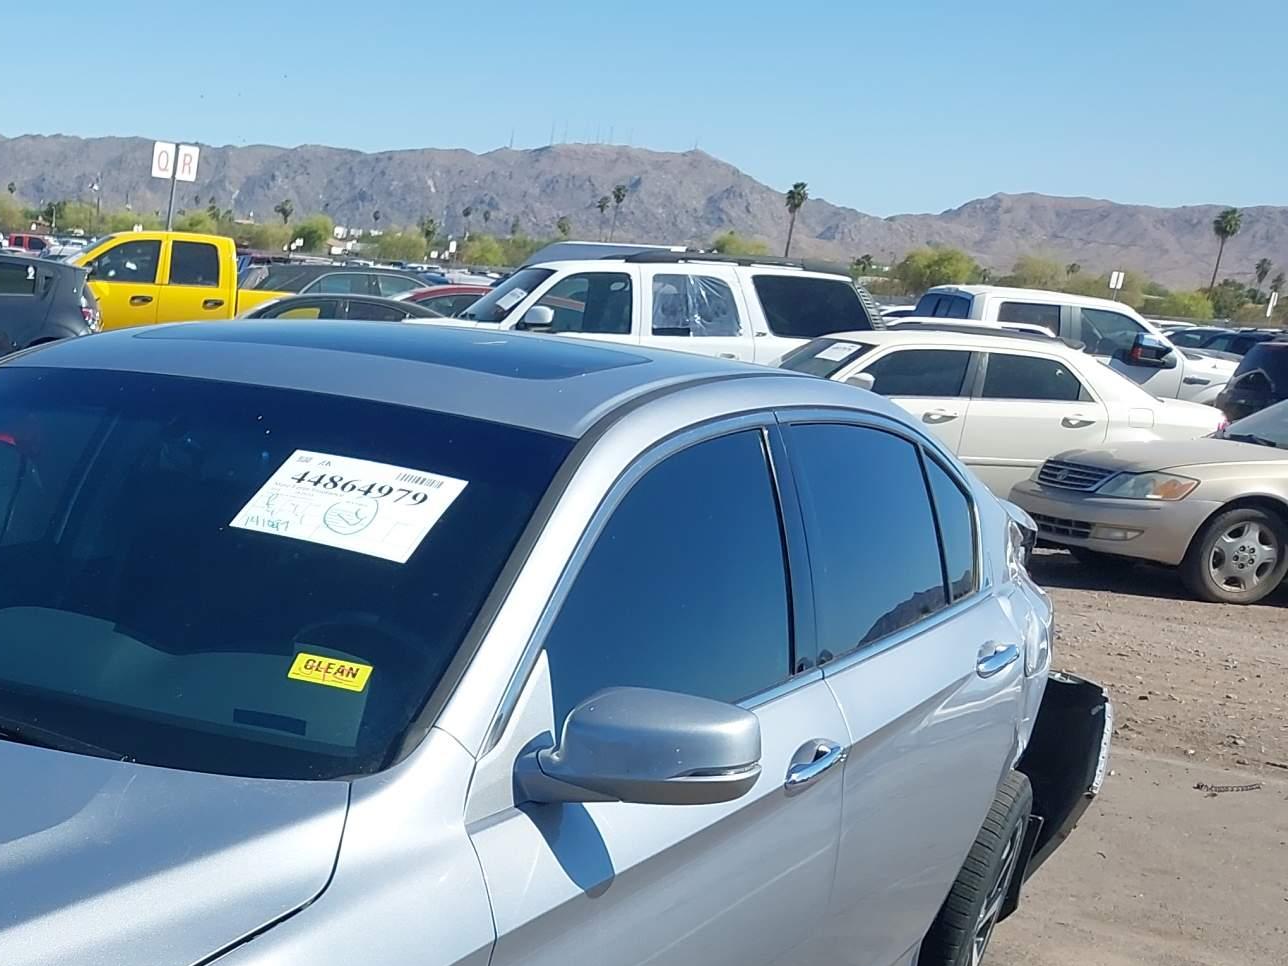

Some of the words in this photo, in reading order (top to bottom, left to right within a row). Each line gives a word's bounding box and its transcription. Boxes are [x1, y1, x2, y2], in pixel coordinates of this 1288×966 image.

[157, 150, 169, 171] Q
[181, 153, 192, 176] R
[291, 470, 429, 506] 44864979
[304, 658, 360, 679] CLEAN
